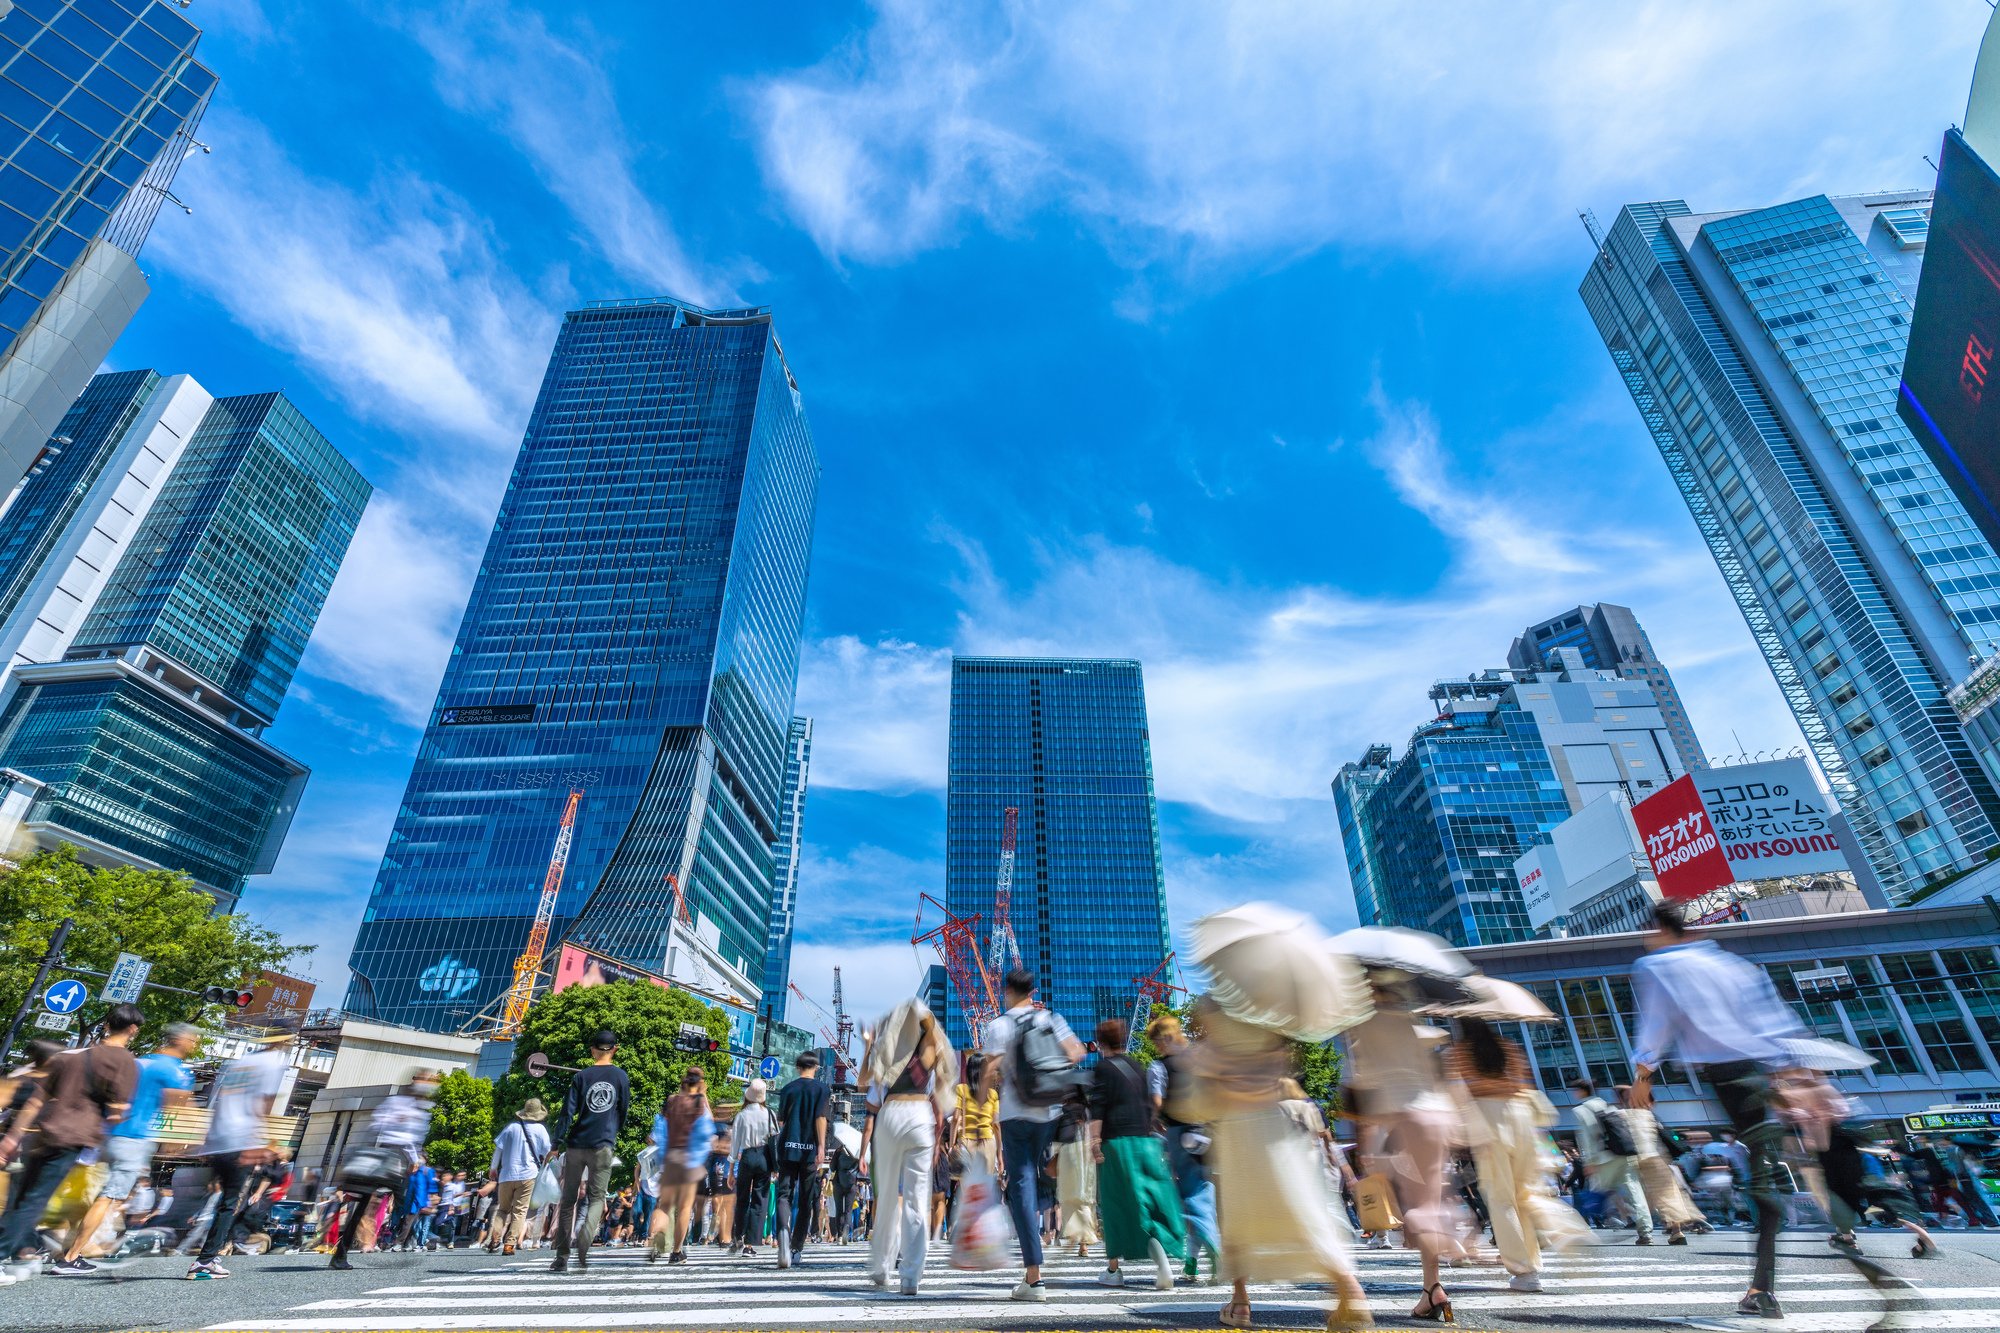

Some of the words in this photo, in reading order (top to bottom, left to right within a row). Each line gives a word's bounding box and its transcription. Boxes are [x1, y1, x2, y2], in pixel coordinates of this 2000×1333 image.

[457, 714, 498, 723] SCRAMBLE
[499, 713, 531, 721] SQUARE
[460, 708, 493, 716] SHIBUYA
[1701, 782, 1789, 806] ココロの
[1711, 799, 1826, 825] ボリューム、
[1646, 811, 1704, 859] カラオケ
[1719, 817, 1831, 841] あげていこう
[1654, 833, 1717, 876] JOYSOUND
[1725, 833, 1840, 862] JOYSOUND
[1520, 868, 1542, 889] 広告募集
[1702, 908, 1730, 925] JOYSOUND
[111, 958, 136, 999] 渋谷駅前
[419, 954, 480, 998] dip
